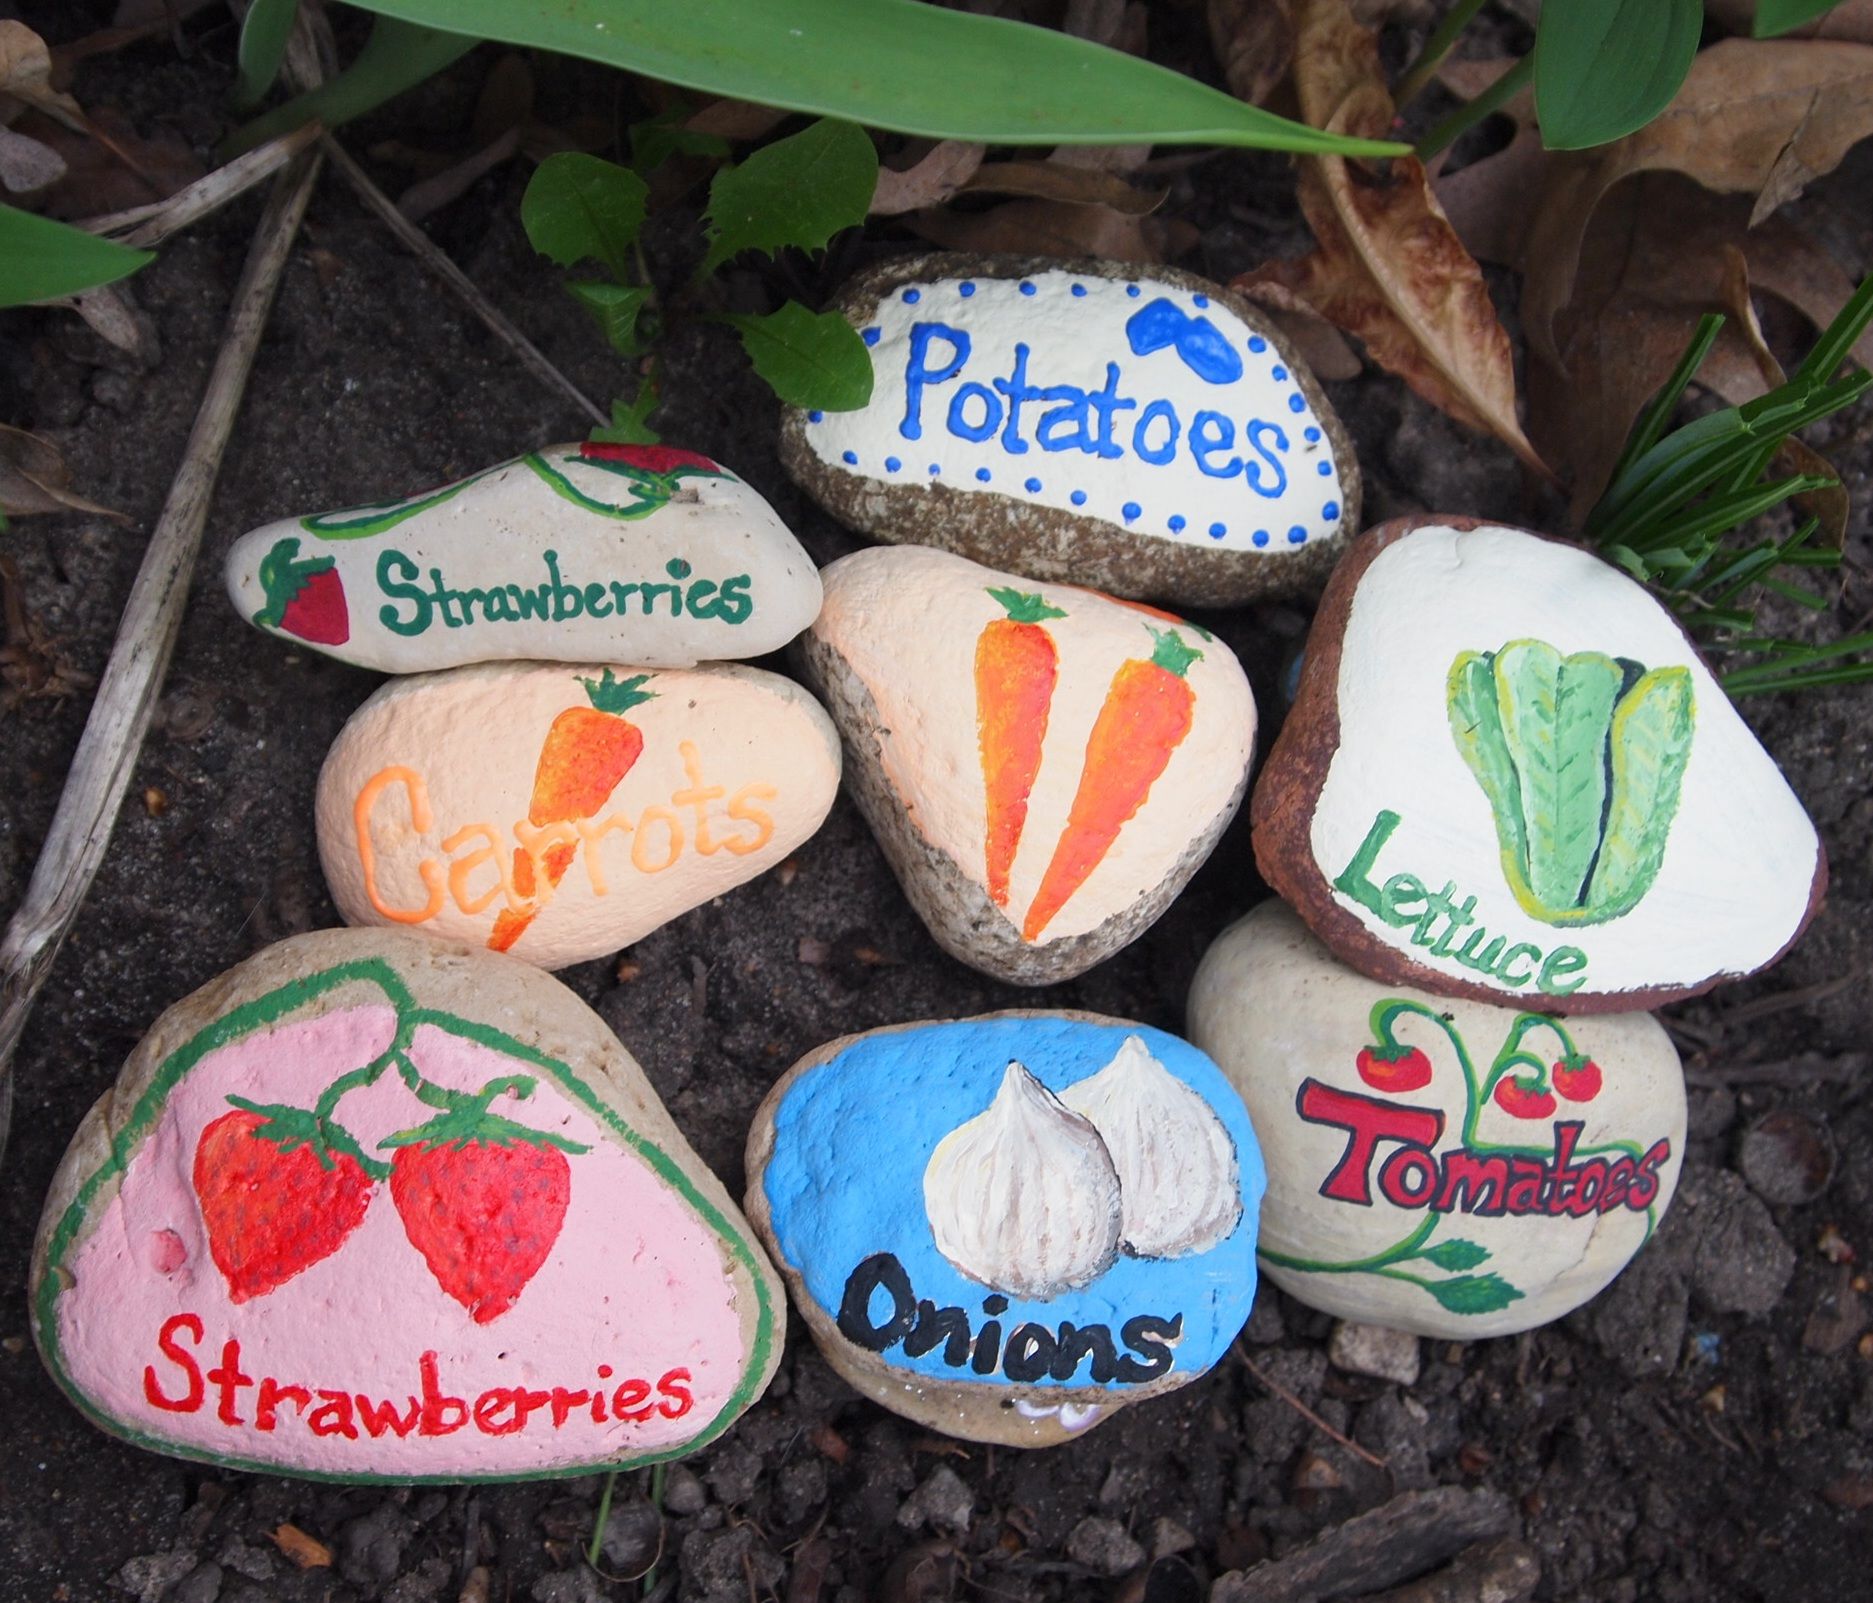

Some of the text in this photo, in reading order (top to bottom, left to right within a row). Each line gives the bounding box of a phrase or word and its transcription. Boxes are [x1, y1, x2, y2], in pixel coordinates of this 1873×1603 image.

[898, 321, 1290, 498] Potatoes
[376, 549, 754, 637] Strawberries
[355, 740, 777, 924] Carrots
[1334, 809, 1588, 994] Lettuce
[1296, 1077, 1671, 1217] Tomatoes
[144, 1312, 693, 1439] Strawberries
[838, 1252, 1183, 1383] Onions
